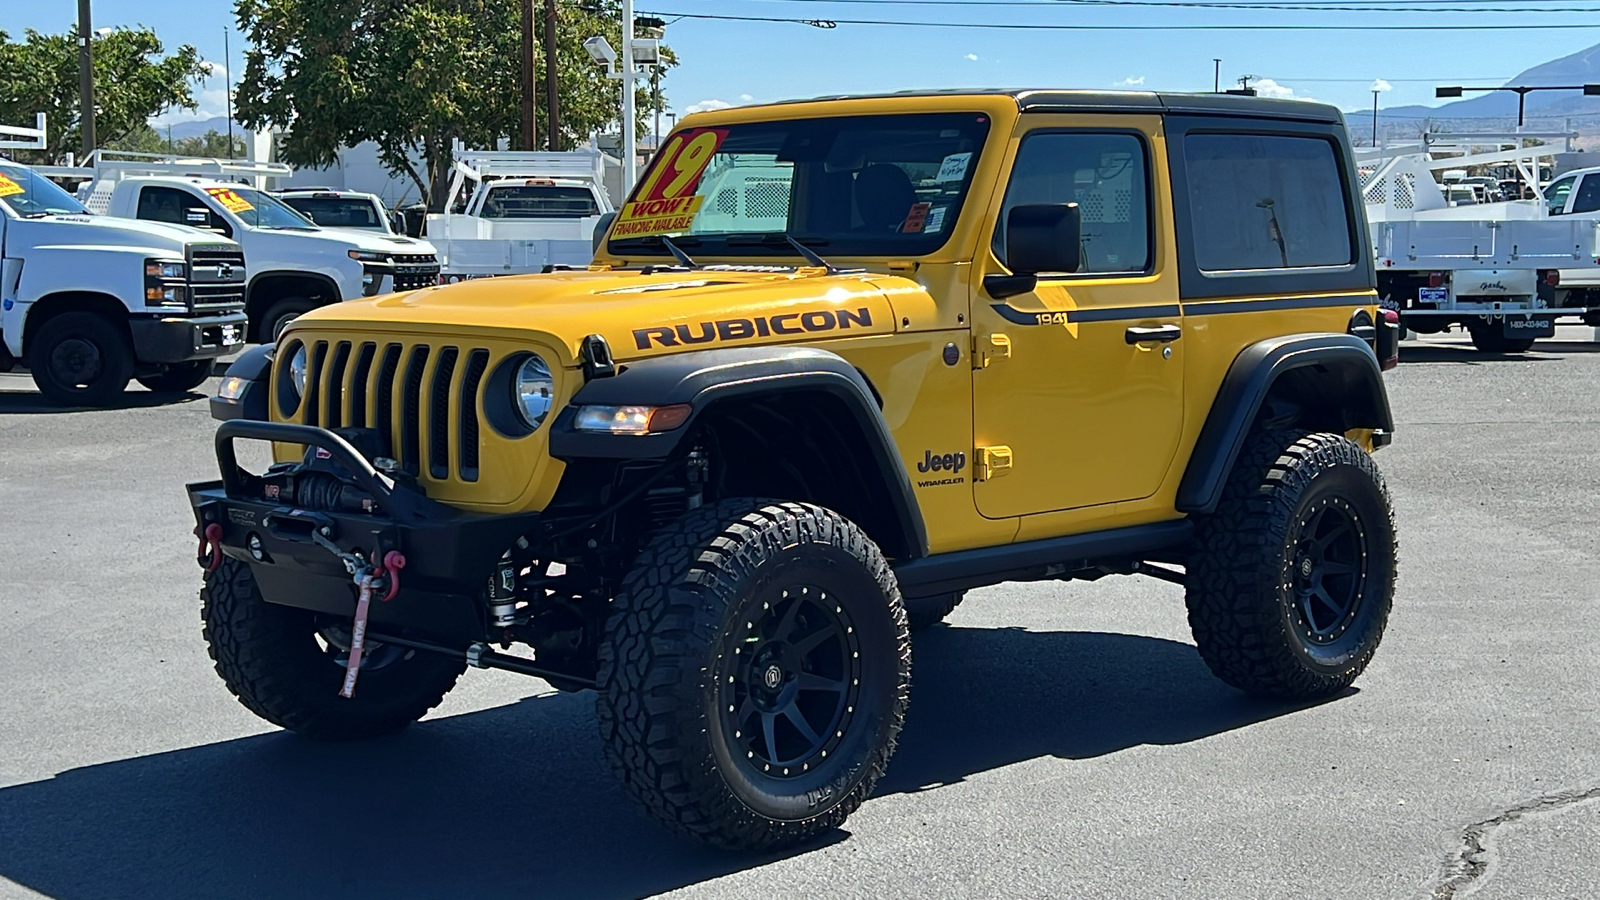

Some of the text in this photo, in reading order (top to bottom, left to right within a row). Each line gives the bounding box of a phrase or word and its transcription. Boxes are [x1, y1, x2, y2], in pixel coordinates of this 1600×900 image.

[635, 131, 717, 202] 19
[613, 216, 692, 236] FINANCING AVAILABLE
[632, 307, 873, 350] RUBICON
[1035, 312, 1068, 325] 1941
[917, 450, 966, 474] Jeep
[917, 477, 964, 488] WRANGLER
[353, 620, 365, 649] WARN
[344, 666, 358, 698] WARN
